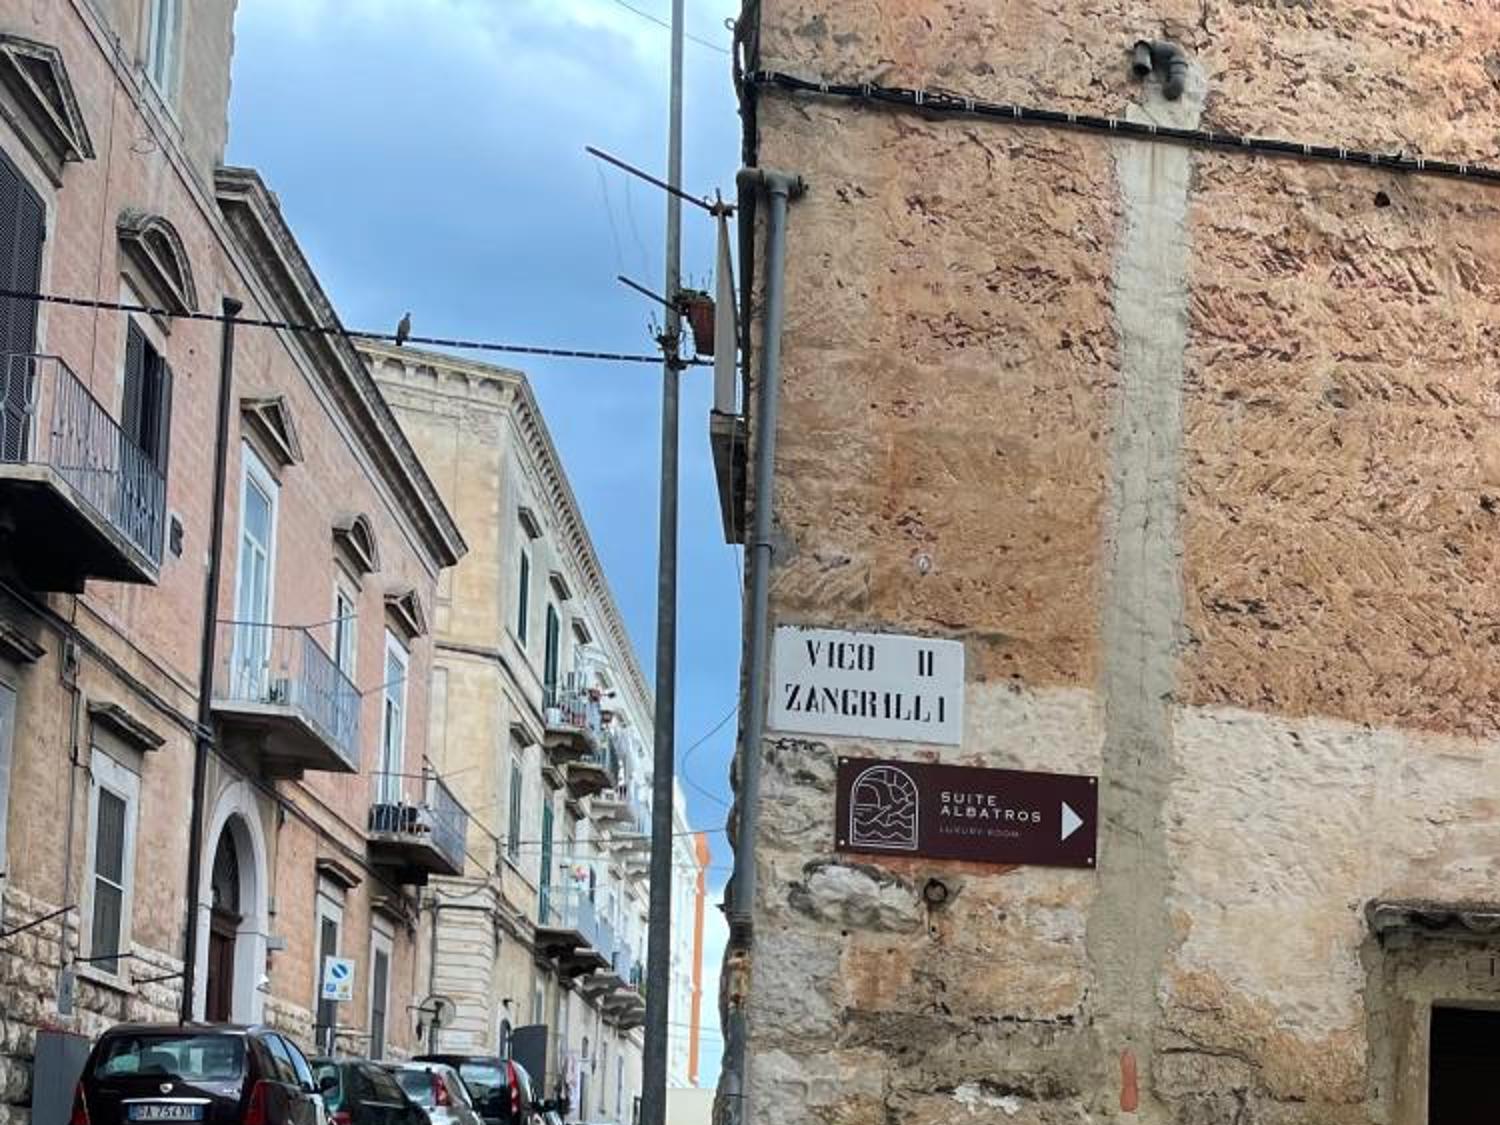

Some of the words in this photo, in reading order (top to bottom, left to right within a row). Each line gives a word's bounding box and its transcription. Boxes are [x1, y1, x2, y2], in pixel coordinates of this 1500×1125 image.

[806, 639, 875, 671] VICO
[918, 649, 934, 677] II
[785, 683, 945, 723] ZANGRILLI
[940, 791, 998, 807] SUITE
[940, 804, 1041, 823] ALBATROS
